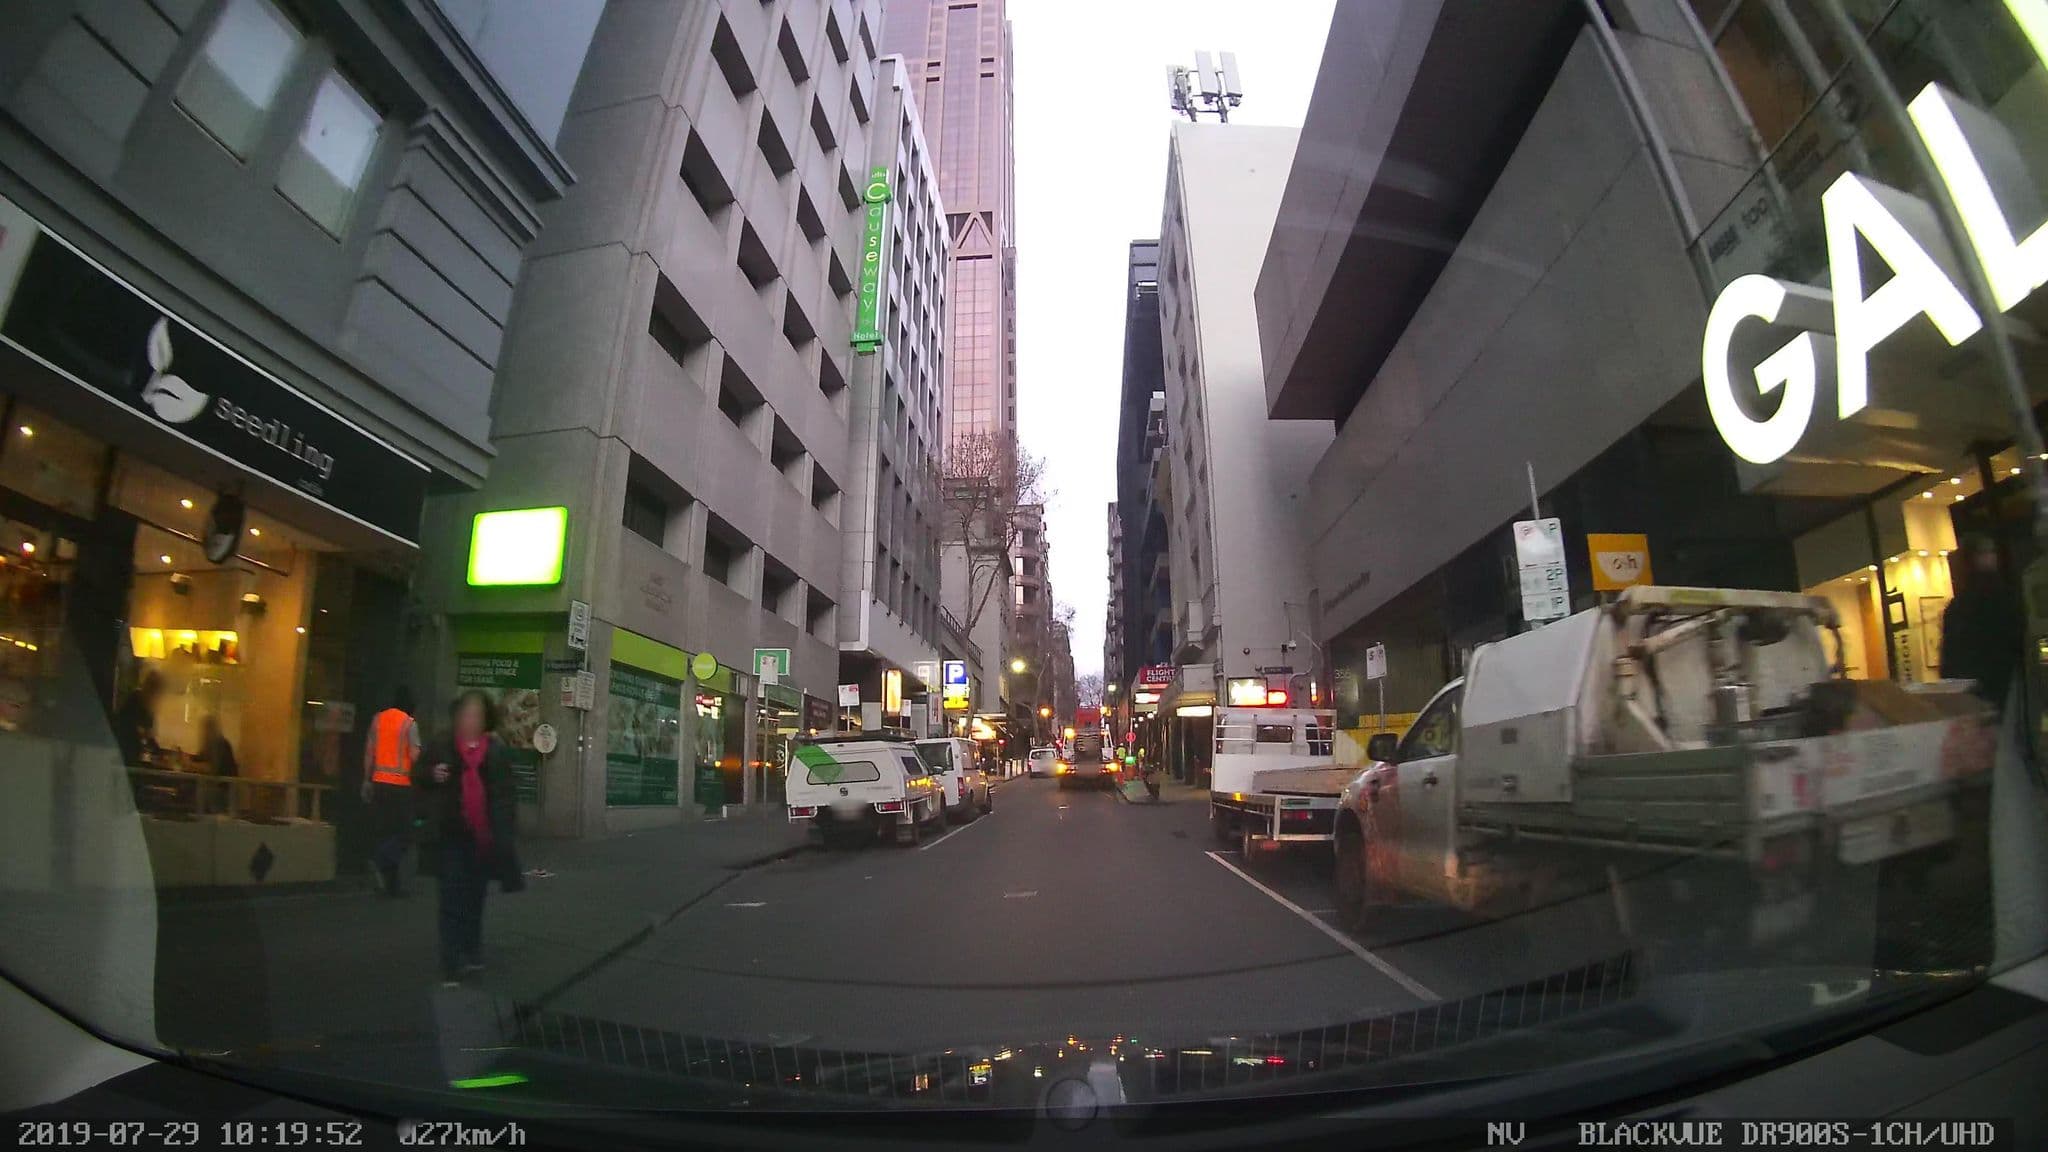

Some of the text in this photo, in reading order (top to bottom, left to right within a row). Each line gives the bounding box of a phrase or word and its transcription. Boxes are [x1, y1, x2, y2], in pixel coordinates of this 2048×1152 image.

[863, 182, 887, 313] Causeway
[1703, 0, 2048, 464] GAL
[214, 396, 334, 480] seedling
[949, 664, 964, 683] P
[1147, 669, 1175, 677] FLIGHT
